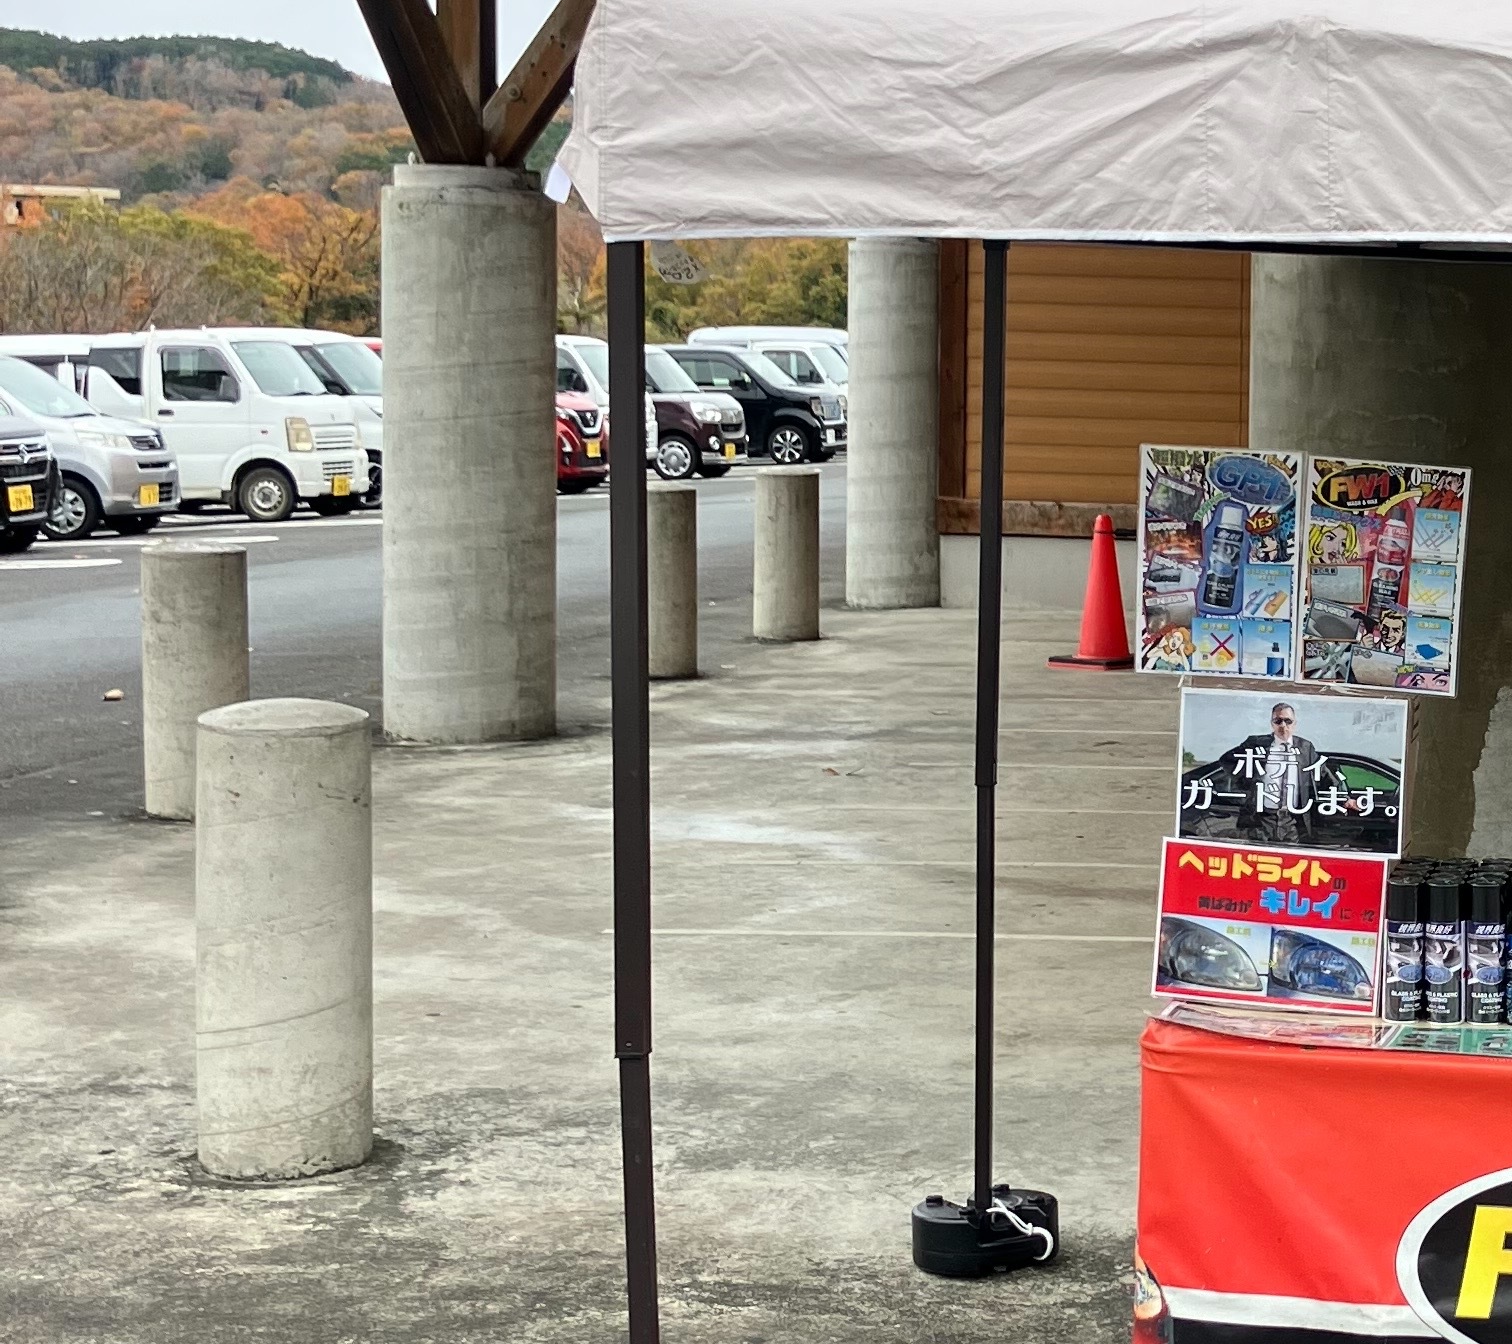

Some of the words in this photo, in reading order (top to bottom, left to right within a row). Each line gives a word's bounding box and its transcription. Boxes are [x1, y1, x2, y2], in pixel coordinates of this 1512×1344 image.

[1330, 471, 1391, 502] FW1
[1232, 746, 1347, 783] ボディ、
[1182, 779, 1398, 817] ガードします。
